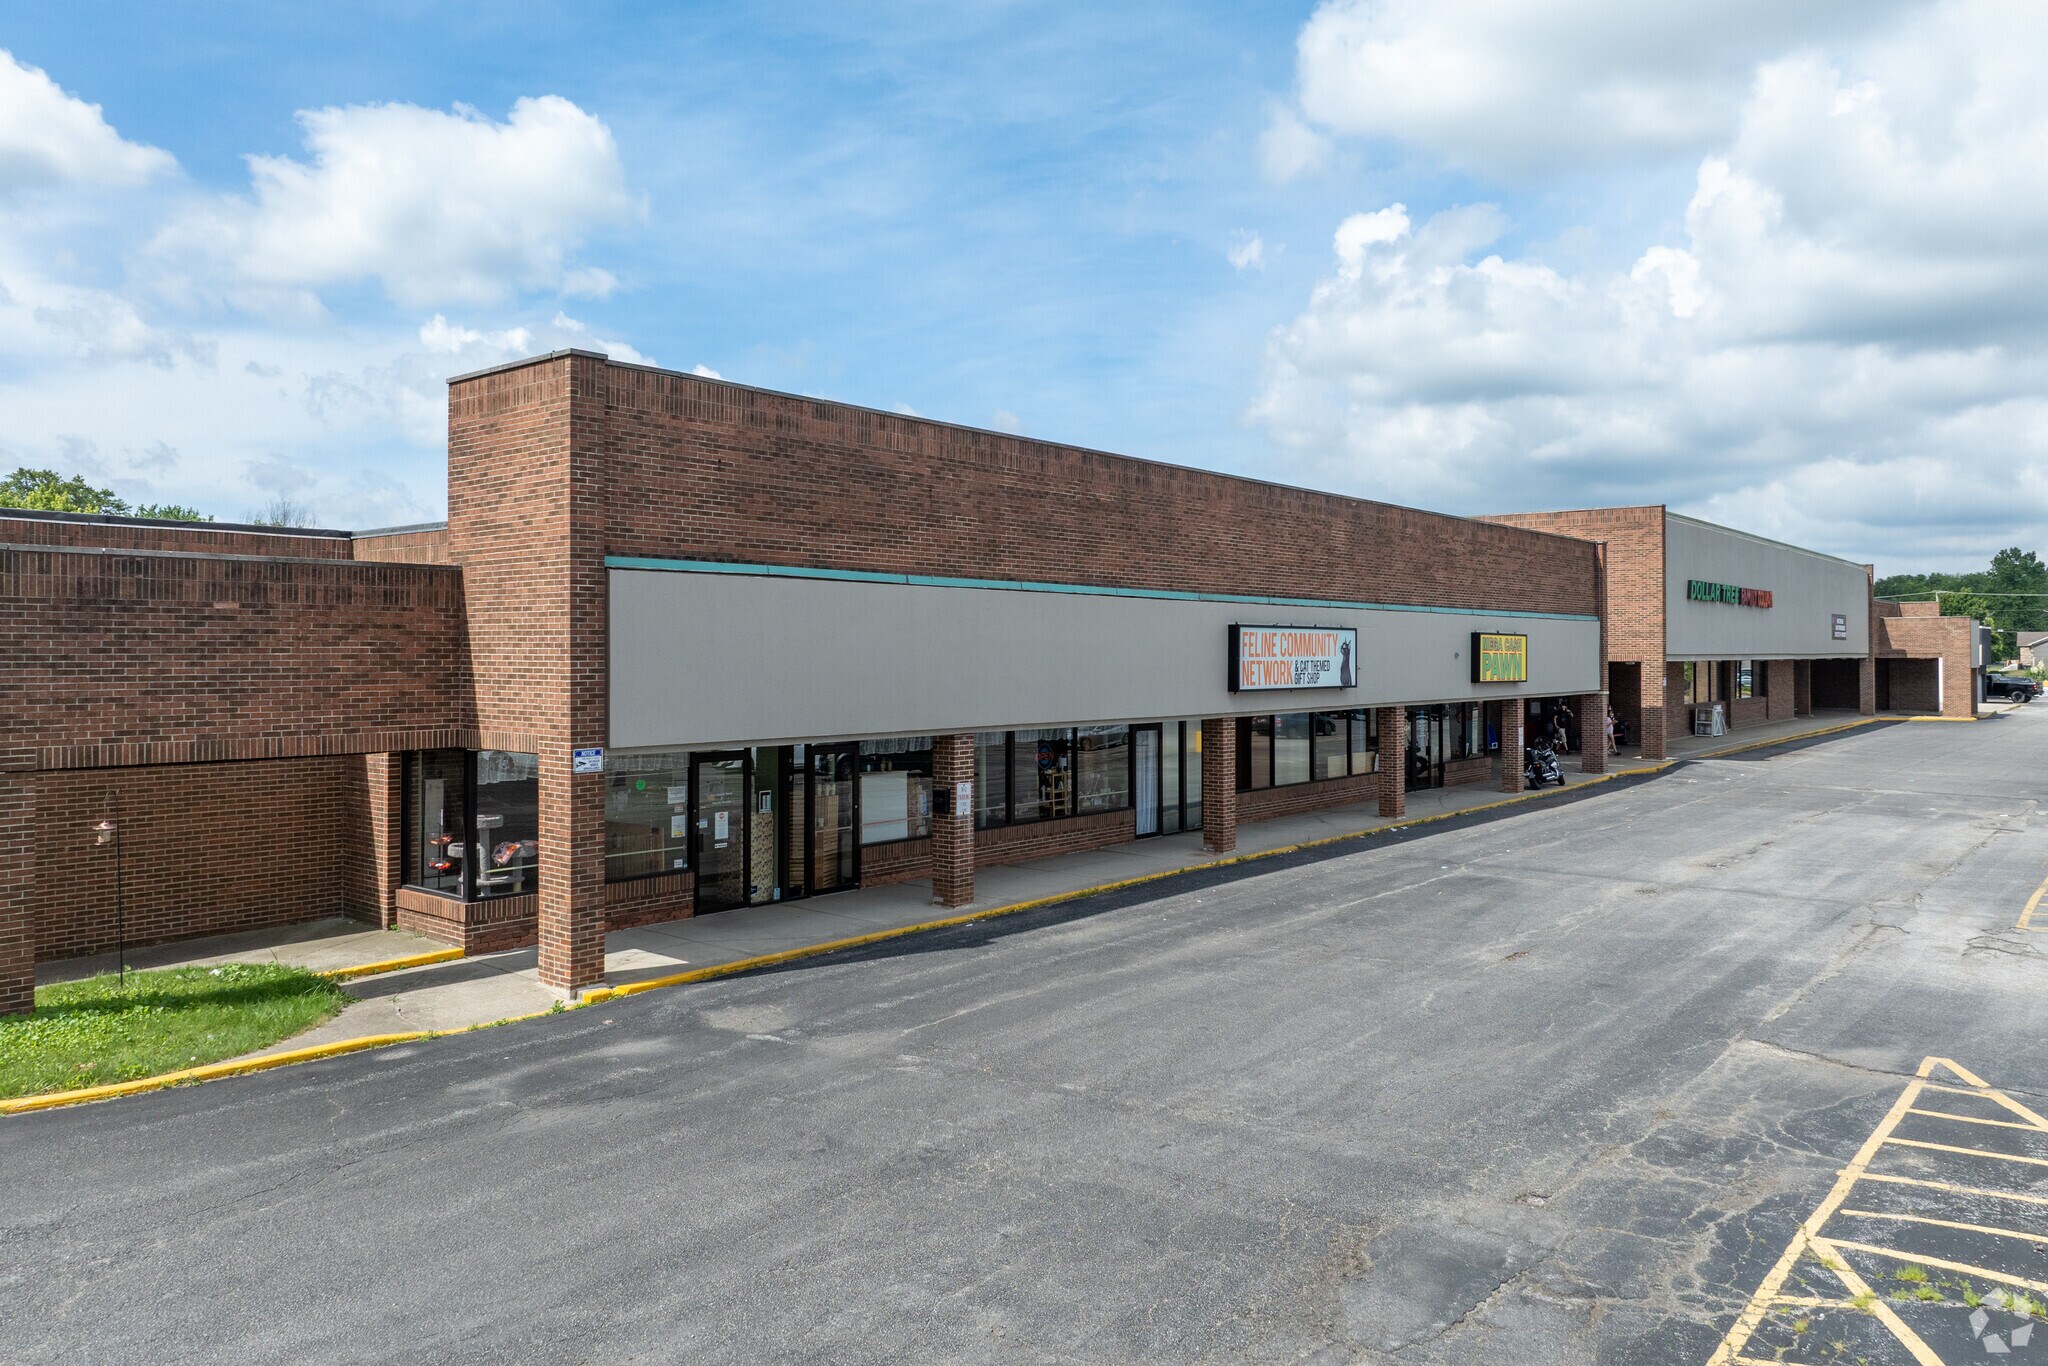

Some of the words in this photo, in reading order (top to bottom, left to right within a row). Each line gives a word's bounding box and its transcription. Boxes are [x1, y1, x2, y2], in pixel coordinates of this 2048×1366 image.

[1690, 580, 1721, 602] DOLLAR
[1722, 584, 1739, 604] TREE
[1242, 631, 1278, 657] FELINE
[1280, 632, 1338, 657] COMMUNITY
[1483, 637, 1503, 651] MEGA
[1242, 660, 1294, 686] NETWORK
[1294, 660, 1299, 672] &
[1300, 660, 1309, 672] CAT
[1310, 660, 1331, 672] THEMED
[1294, 673, 1306, 685] GIFT
[1306, 672, 1320, 685] SHOP
[1482, 652, 1522, 680] PAWN
